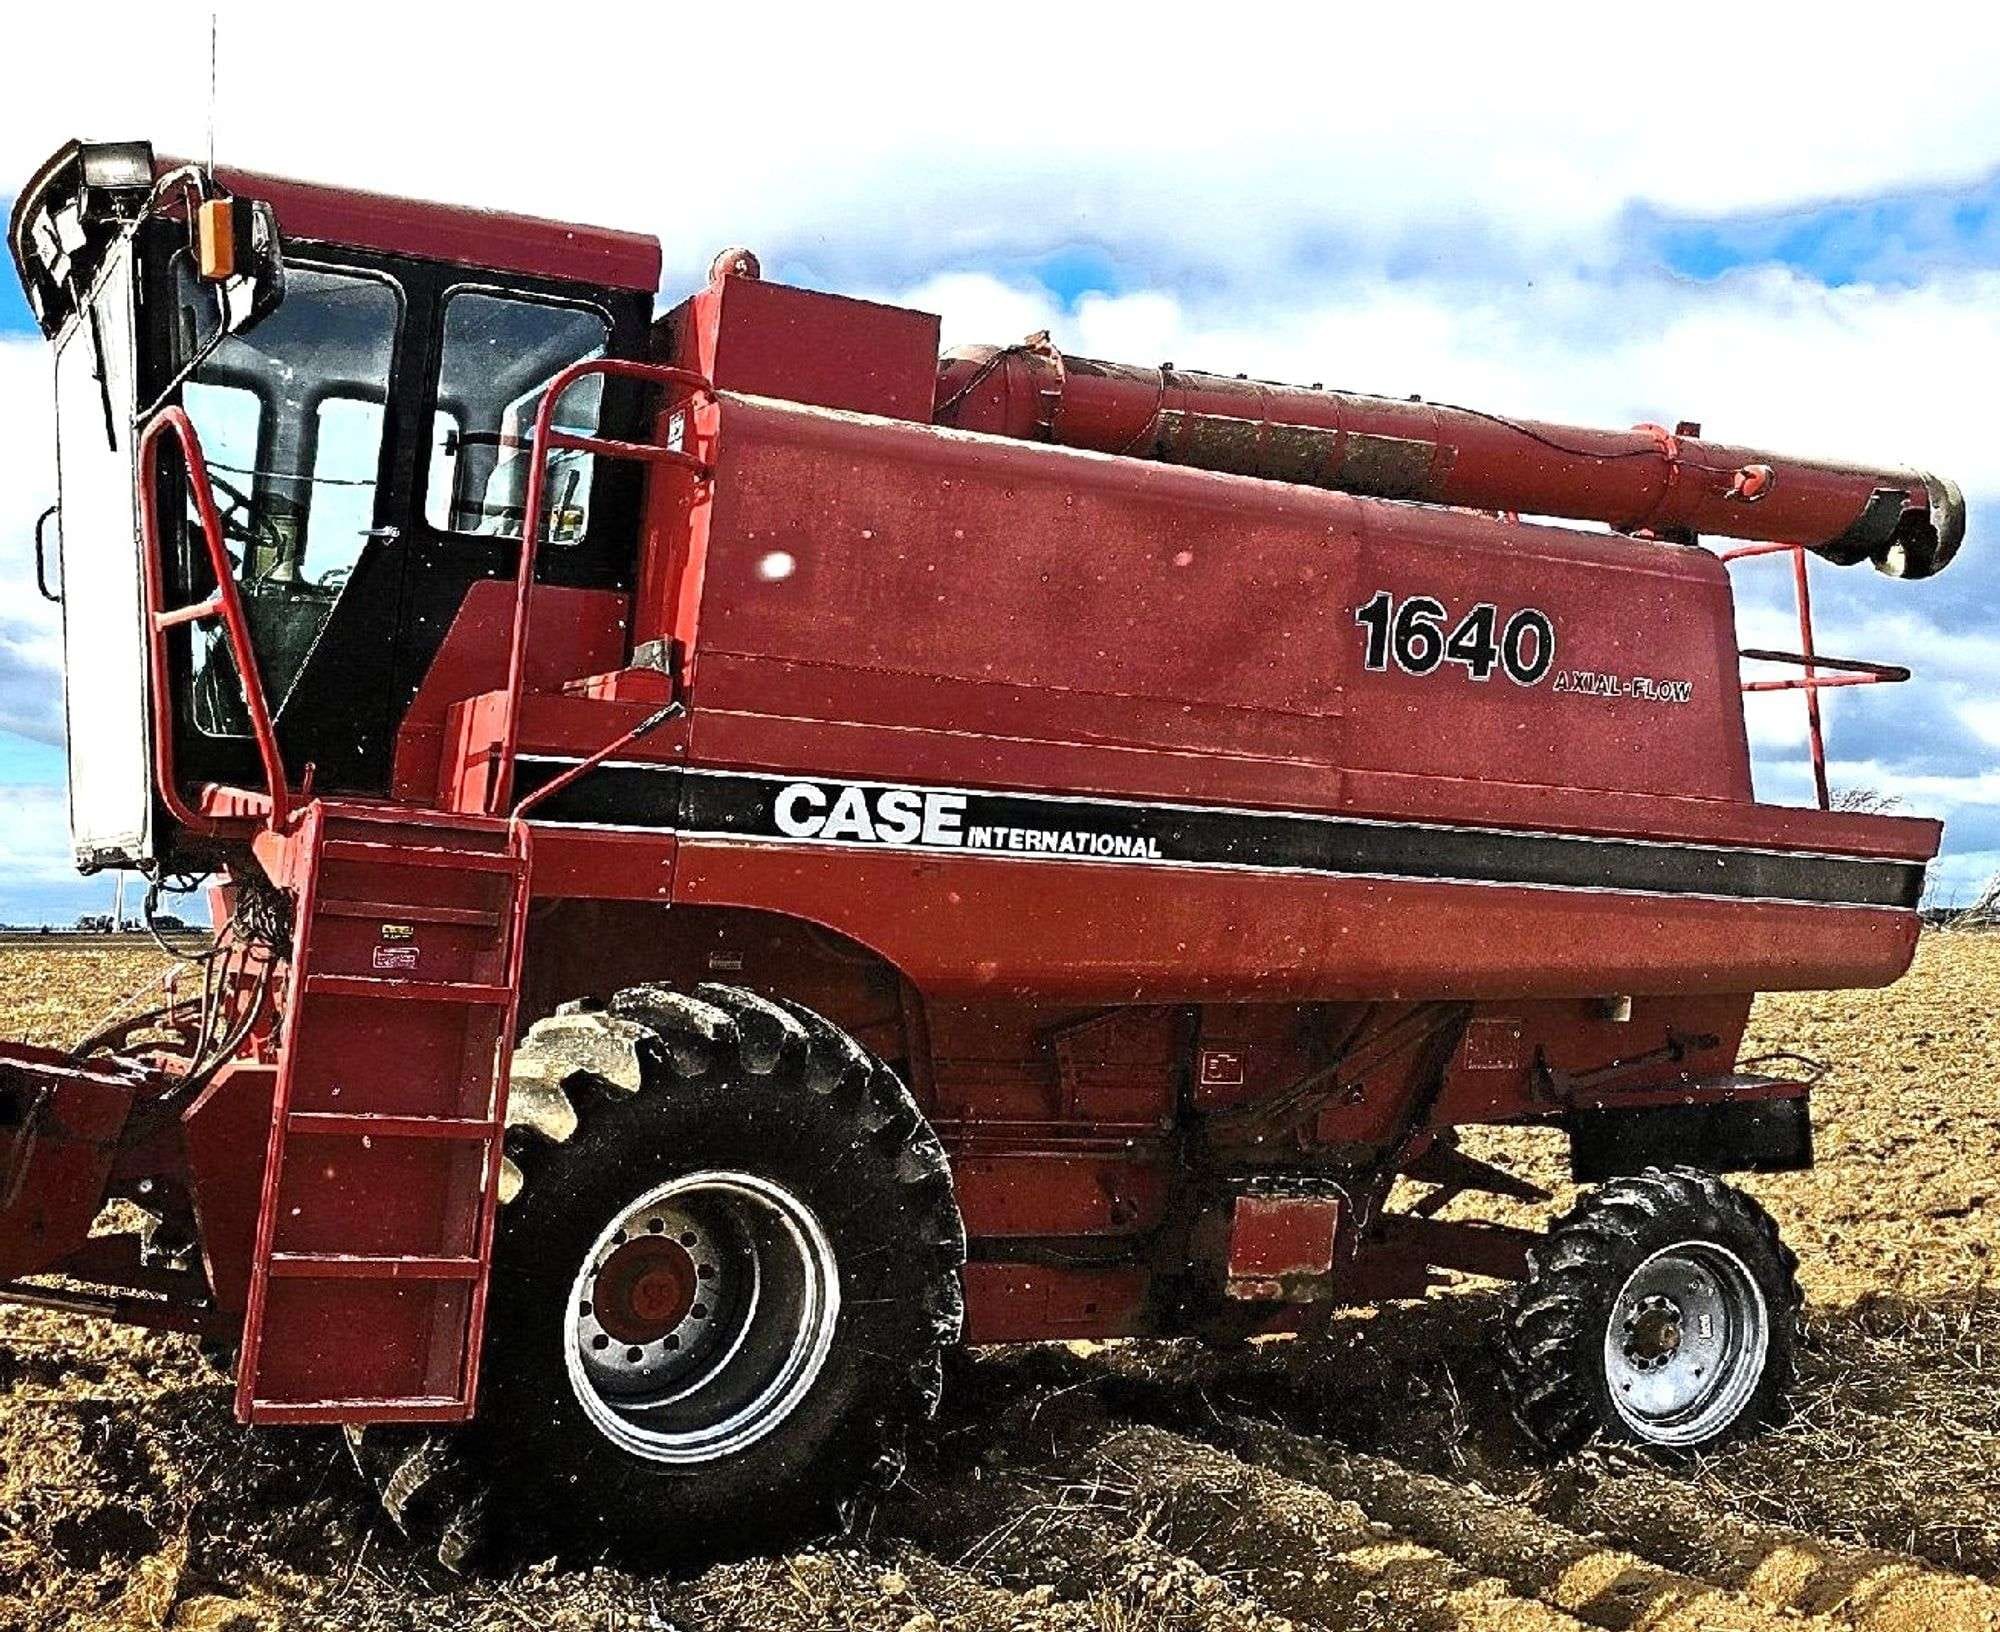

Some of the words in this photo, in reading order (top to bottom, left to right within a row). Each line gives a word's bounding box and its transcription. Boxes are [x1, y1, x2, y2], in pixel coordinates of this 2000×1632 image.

[1356, 590, 1555, 687] 1640
[1553, 671, 1693, 702] AXIAL-FLOW
[774, 782, 967, 846] CASE
[967, 826, 1162, 859] INTERNATIONAL
